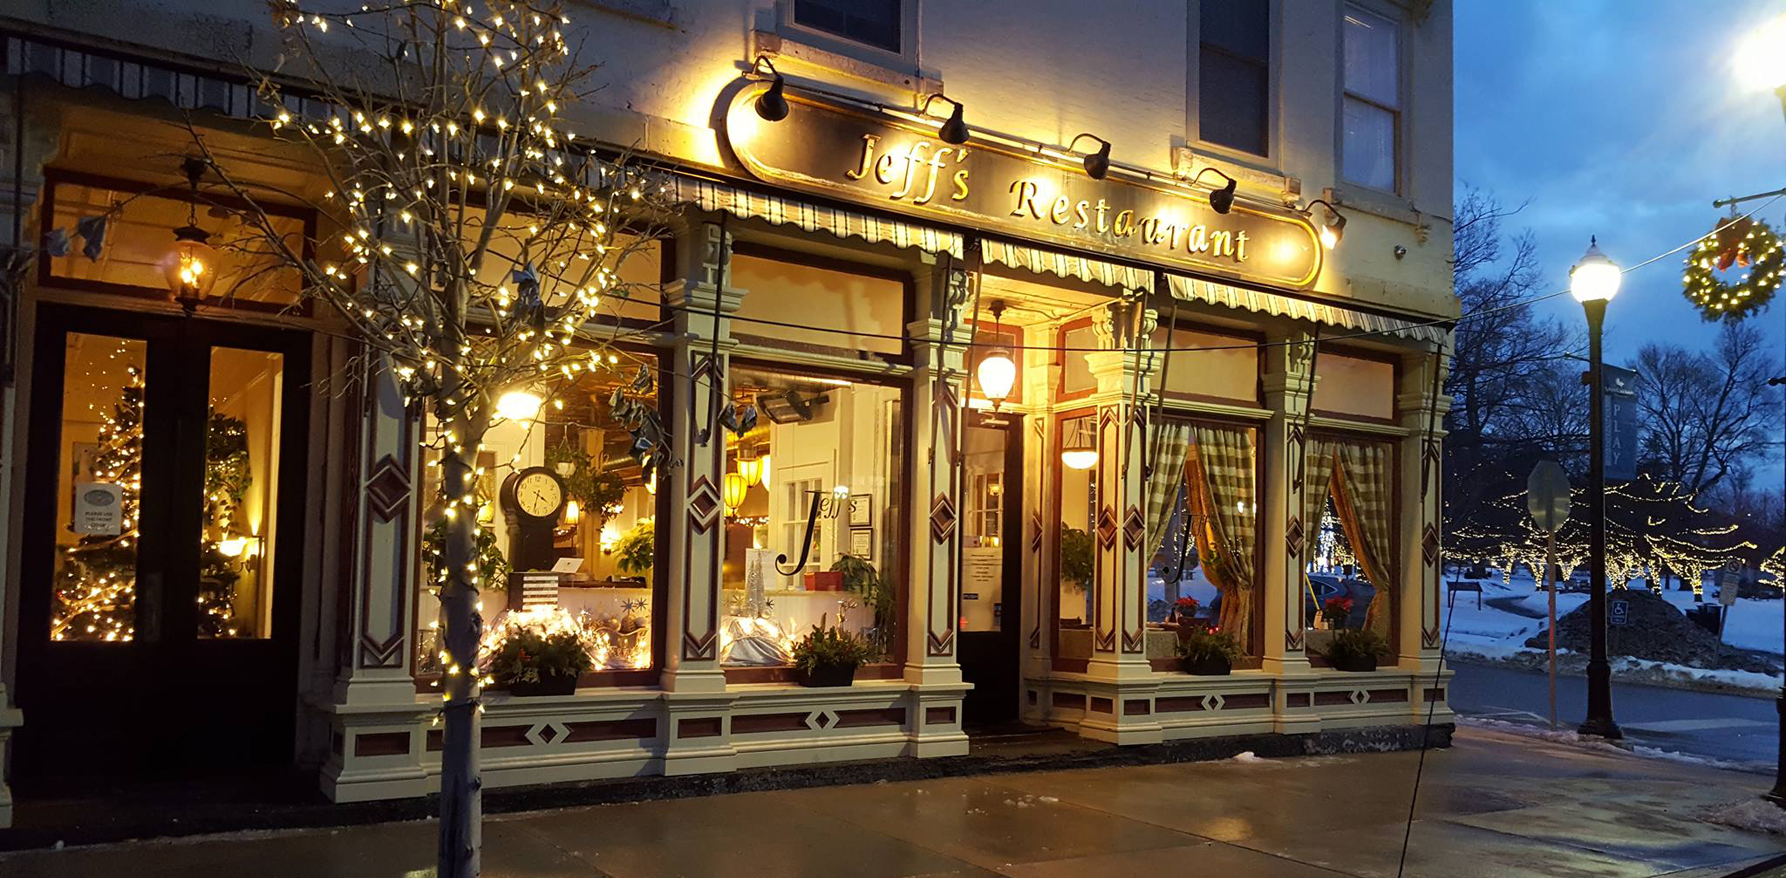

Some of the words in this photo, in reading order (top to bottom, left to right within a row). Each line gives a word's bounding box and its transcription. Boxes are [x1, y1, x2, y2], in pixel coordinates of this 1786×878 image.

[847, 134, 969, 204] Jeff's
[1009, 180, 1250, 263] Restaurant
[1612, 404, 1621, 465] PLAY
[775, 490, 857, 576] Jeffs
